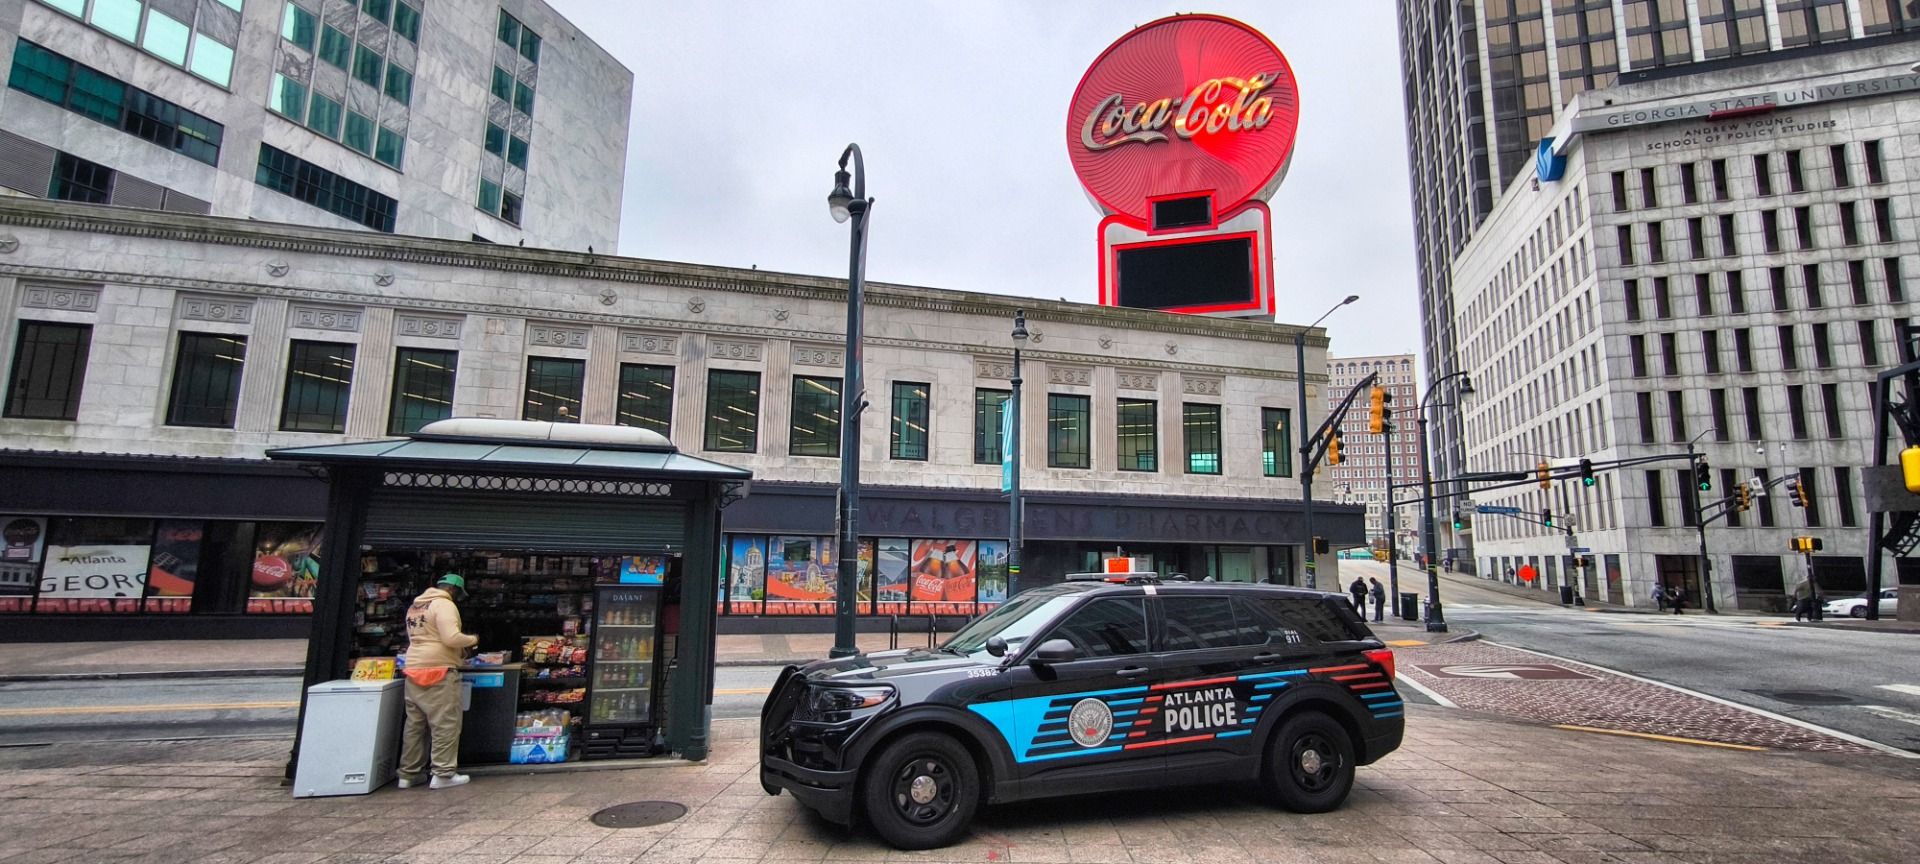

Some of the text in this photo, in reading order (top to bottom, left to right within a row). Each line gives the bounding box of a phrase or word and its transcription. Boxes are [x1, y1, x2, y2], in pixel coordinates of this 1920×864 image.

[1081, 71, 1281, 150] Coca-Cola
[1607, 75, 1920, 126] GEORGIA STATE UNIVERSITY
[1647, 119, 1838, 150] SCHOOL OF POLICY STUDIES
[1684, 115, 1794, 138] ANDREW YOUNG
[866, 504, 1093, 531] WALGRENS
[69, 555, 127, 565] Atlanta
[1285, 635, 1301, 643] 911
[1164, 687, 1234, 706] ATLANTA
[1165, 702, 1237, 733] POLICE
